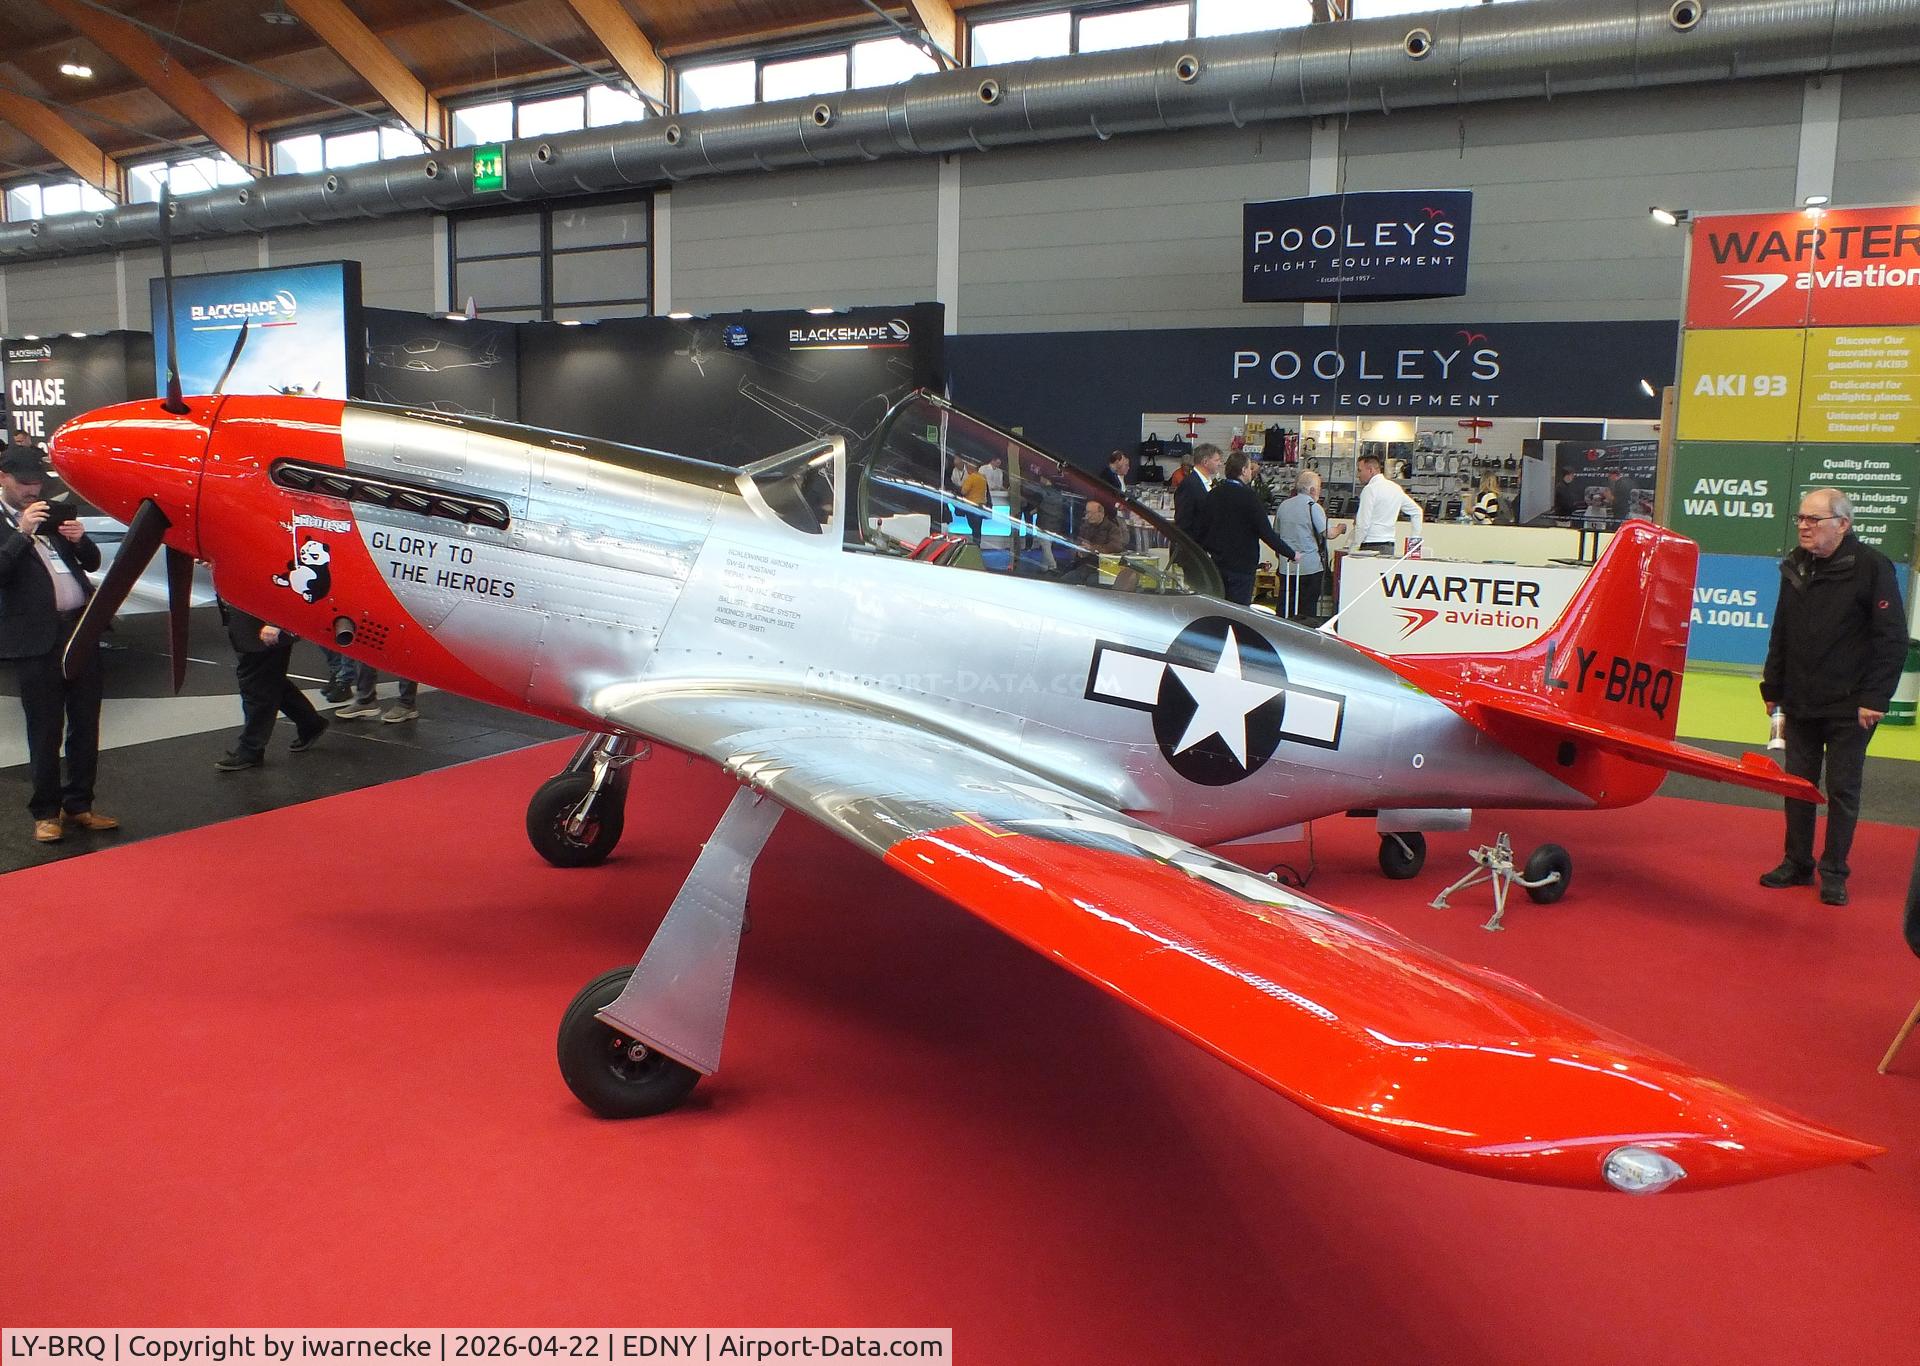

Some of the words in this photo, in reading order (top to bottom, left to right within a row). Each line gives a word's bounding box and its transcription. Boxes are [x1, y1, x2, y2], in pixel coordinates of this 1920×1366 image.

[1254, 222, 1455, 254] POOLEYS
[1708, 224, 1920, 264] WARTER
[1253, 260, 1318, 273] FLIGHT
[1331, 256, 1455, 269] EQUIPMENT
[1795, 264, 1920, 290] aviation
[191, 300, 278, 320] BLACKSHAPE
[789, 327, 888, 342] BLACKSHAPE
[1233, 348, 1500, 381] POOLEYS
[11, 378, 66, 406] CHASE
[1693, 374, 1747, 397] AKI
[1753, 374, 1788, 397] 93
[1231, 394, 1321, 406] FLIGHT
[1340, 394, 1500, 407] EQUIPMENT
[12, 410, 46, 437] THE
[1823, 459, 1862, 470] Quality
[1863, 459, 1890, 469] from
[1693, 478, 1768, 496] AVGAS
[1809, 472, 1834, 481] pure
[1835, 472, 1902, 482] components
[1683, 499, 1719, 516] WA
[1723, 500, 1776, 518] UL91
[1862, 492, 1908, 505] industry
[1852, 505, 1897, 514] andards
[1866, 524, 1887, 533] and
[372, 532, 438, 558] GLORY
[449, 545, 474, 564] TO
[1858, 535, 1883, 545] Free
[390, 561, 429, 584] THE
[436, 569, 516, 598] HEROES
[1380, 572, 1541, 608] WARTER
[1444, 608, 1539, 630] aviation
[1707, 609, 1769, 629] 100LL
[1543, 639, 1674, 720] LY-BRQ
